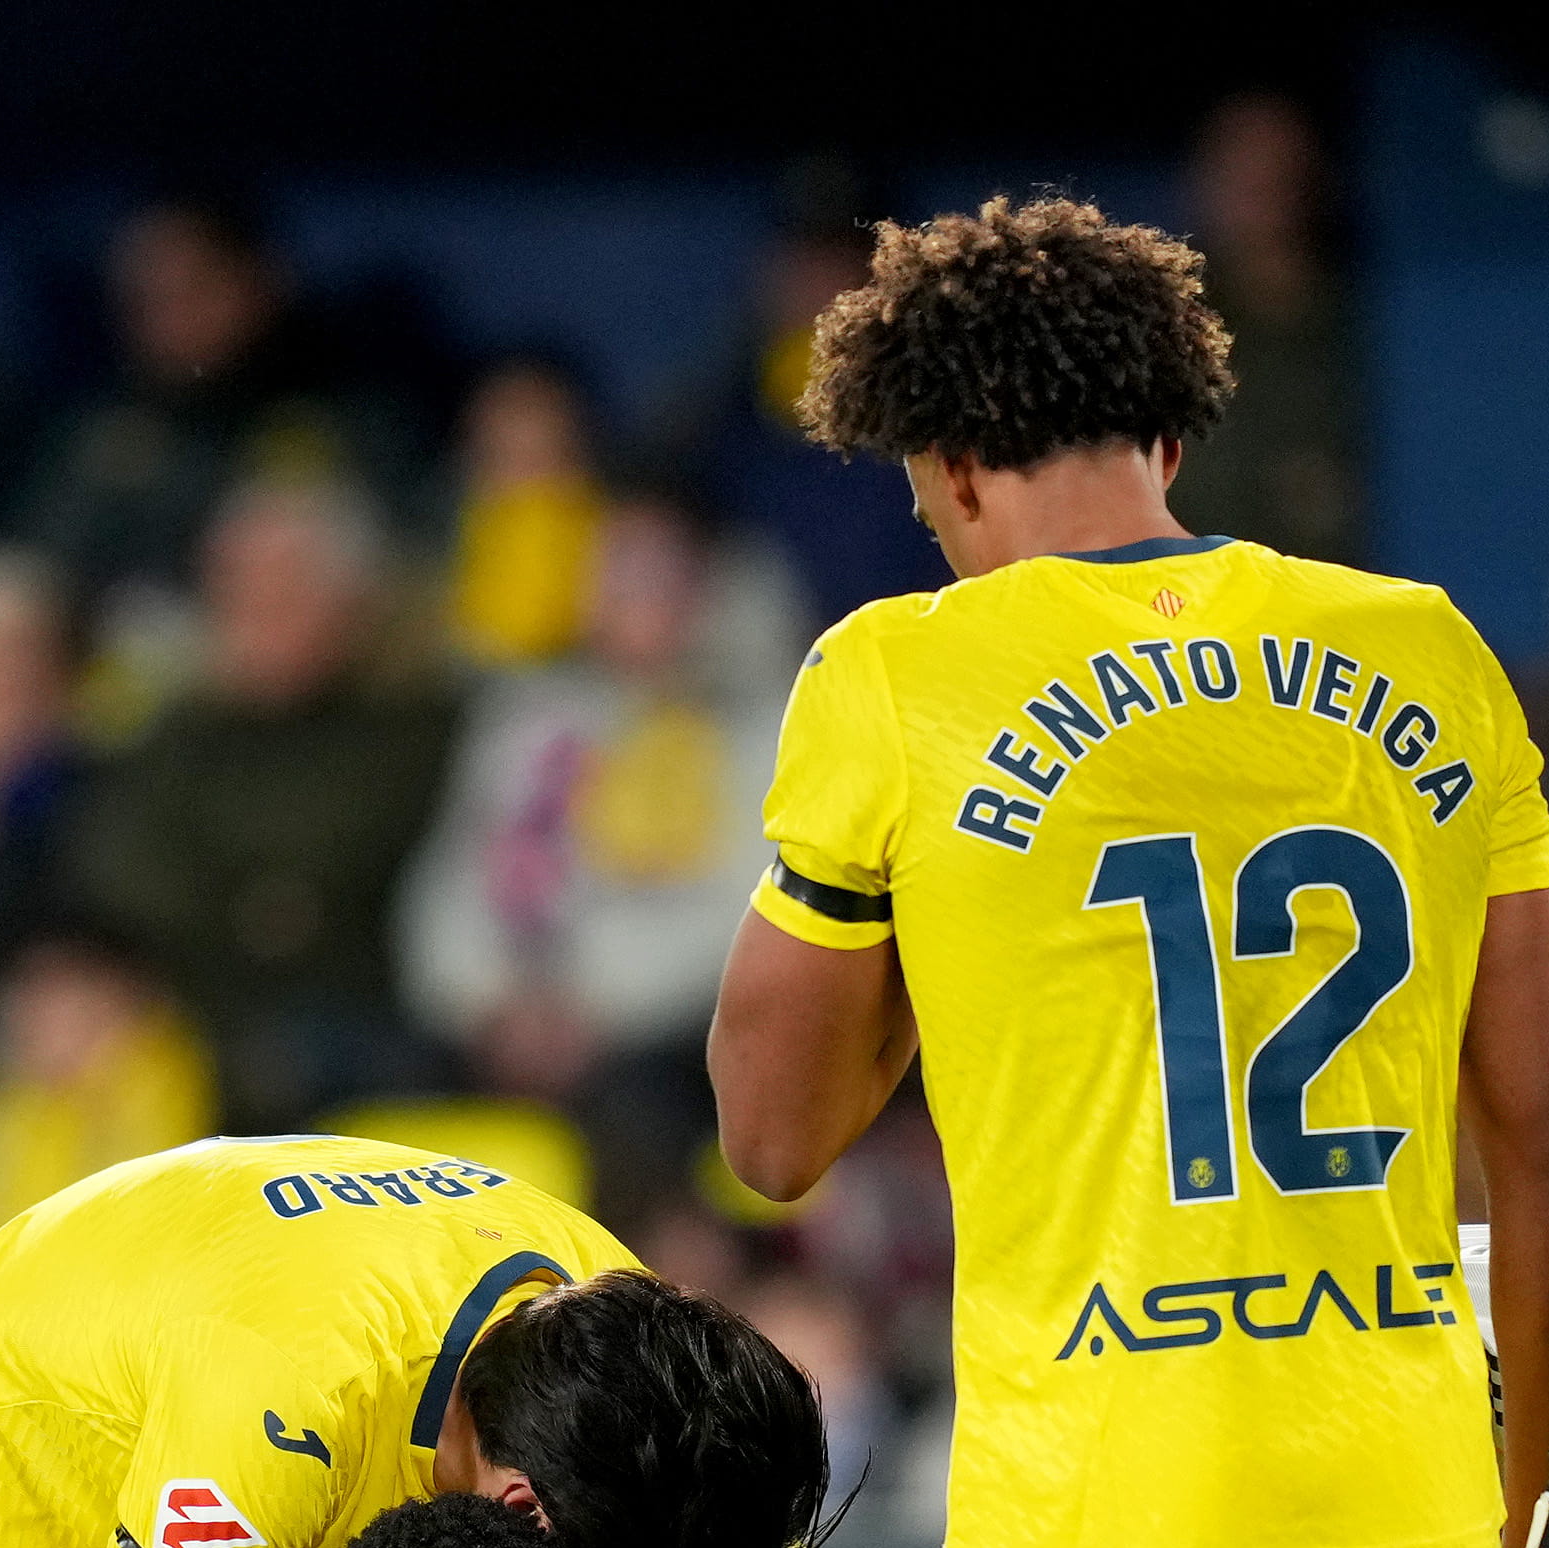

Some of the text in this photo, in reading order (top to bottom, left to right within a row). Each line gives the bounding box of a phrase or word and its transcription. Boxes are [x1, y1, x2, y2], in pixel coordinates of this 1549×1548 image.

[953, 634, 1476, 854] RENATO VEIGA
[1082, 825, 1413, 1206] 12
[262, 1156, 510, 1220] ERARD
[1054, 1262, 1457, 1362] ASCALE
